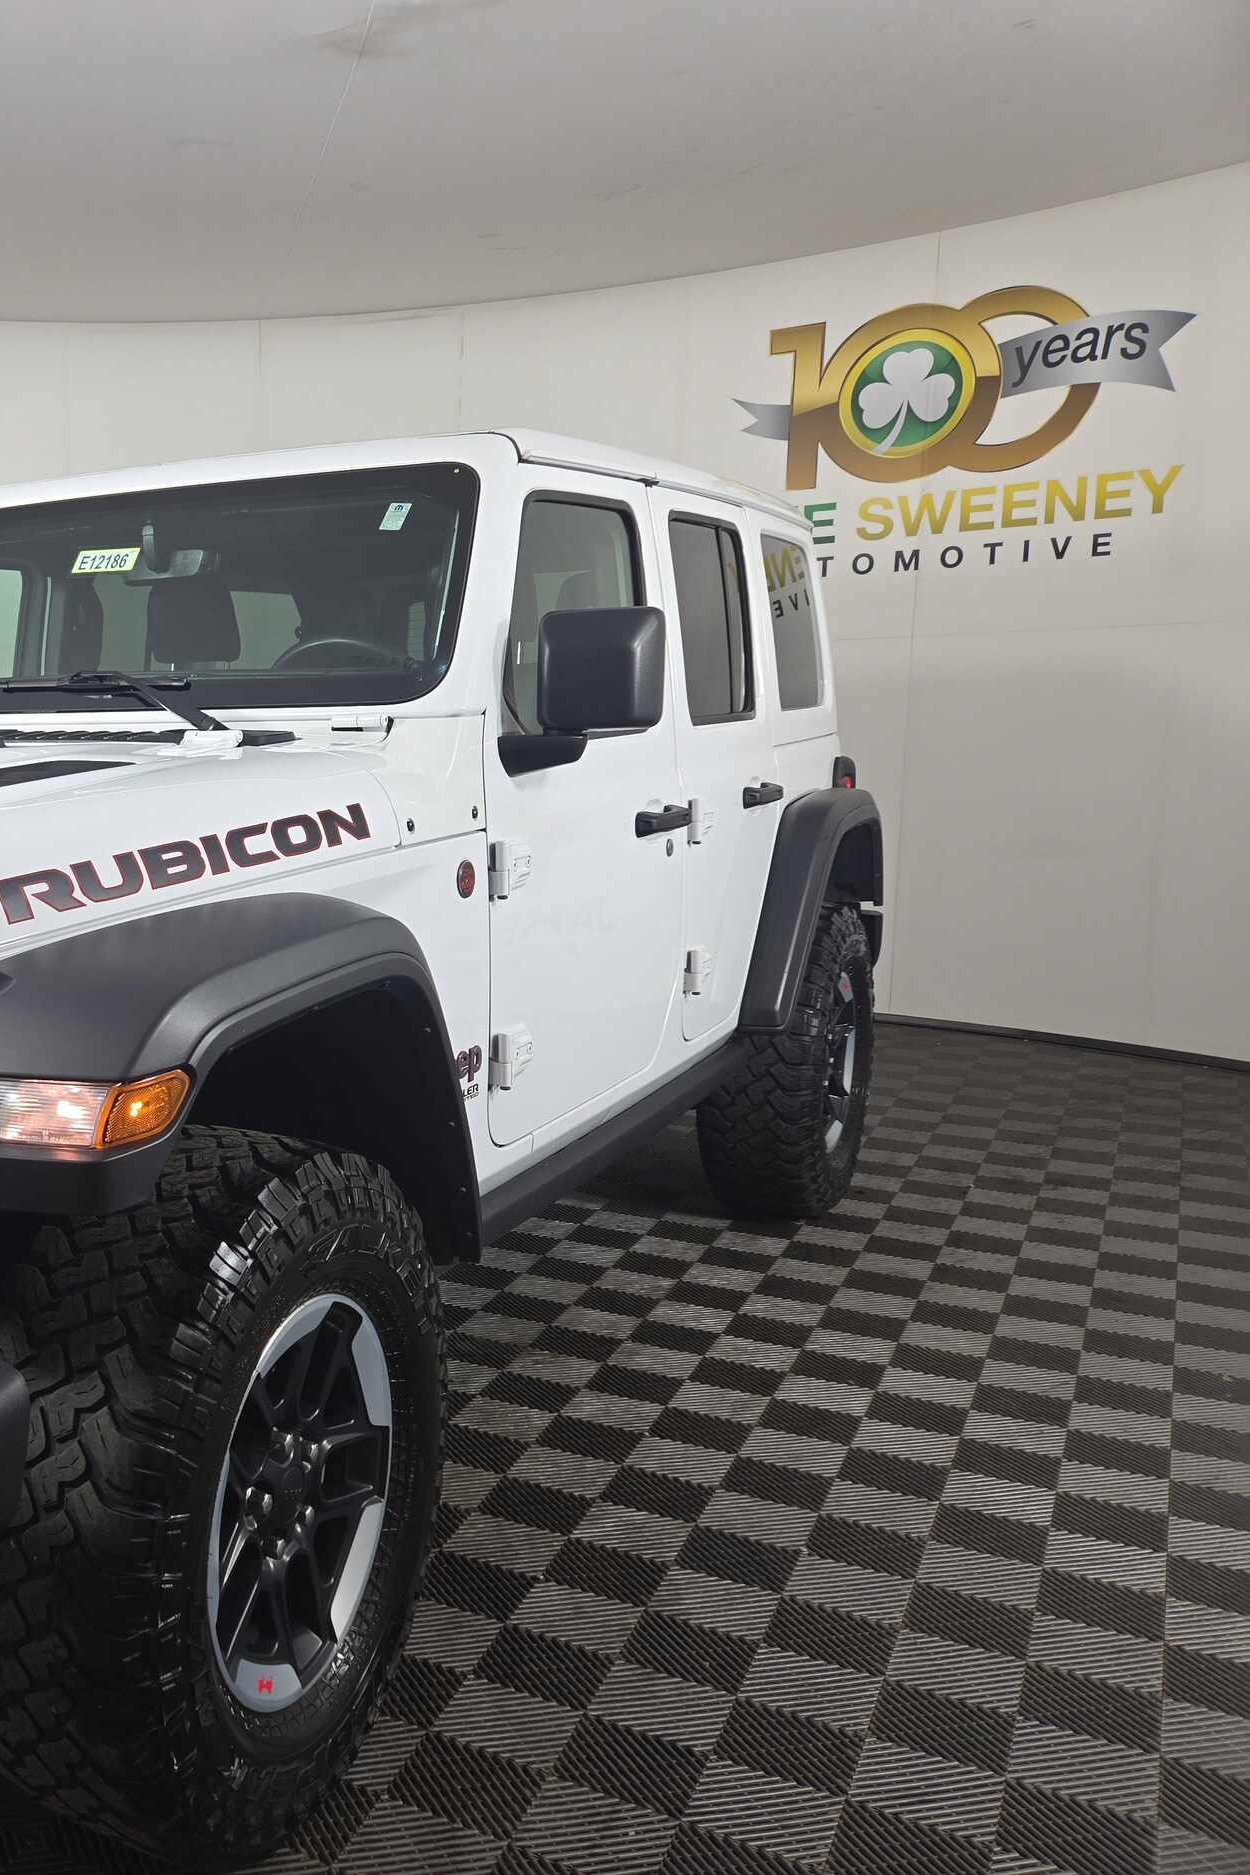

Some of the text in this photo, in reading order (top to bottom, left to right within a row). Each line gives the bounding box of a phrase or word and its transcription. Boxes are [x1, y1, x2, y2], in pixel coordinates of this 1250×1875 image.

[1011, 320, 1151, 388] years
[856, 464, 1185, 541] SWEENEY
[78, 553, 130, 571] E12186
[816, 532, 1112, 577] TOMOTIVE
[456, 1045, 483, 1083] ep
